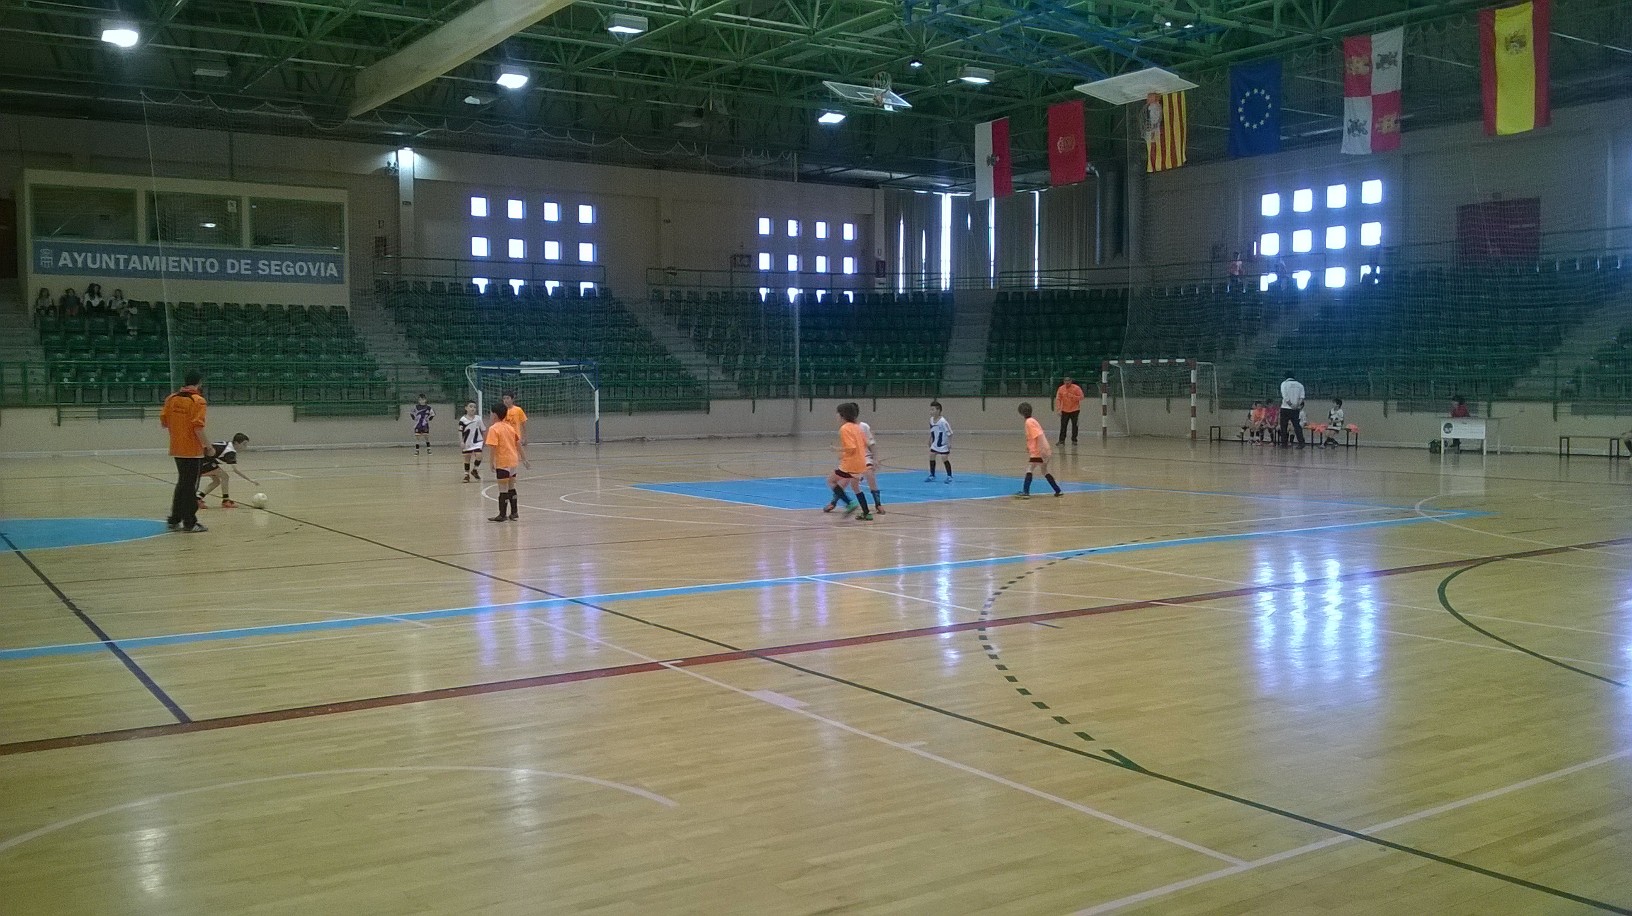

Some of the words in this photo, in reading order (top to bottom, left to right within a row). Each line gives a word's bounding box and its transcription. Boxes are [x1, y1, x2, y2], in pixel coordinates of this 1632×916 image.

[58, 251, 219, 274] AYUNTAMIENTO
[227, 258, 252, 275] DE
[257, 259, 338, 277] SEGOVIA
